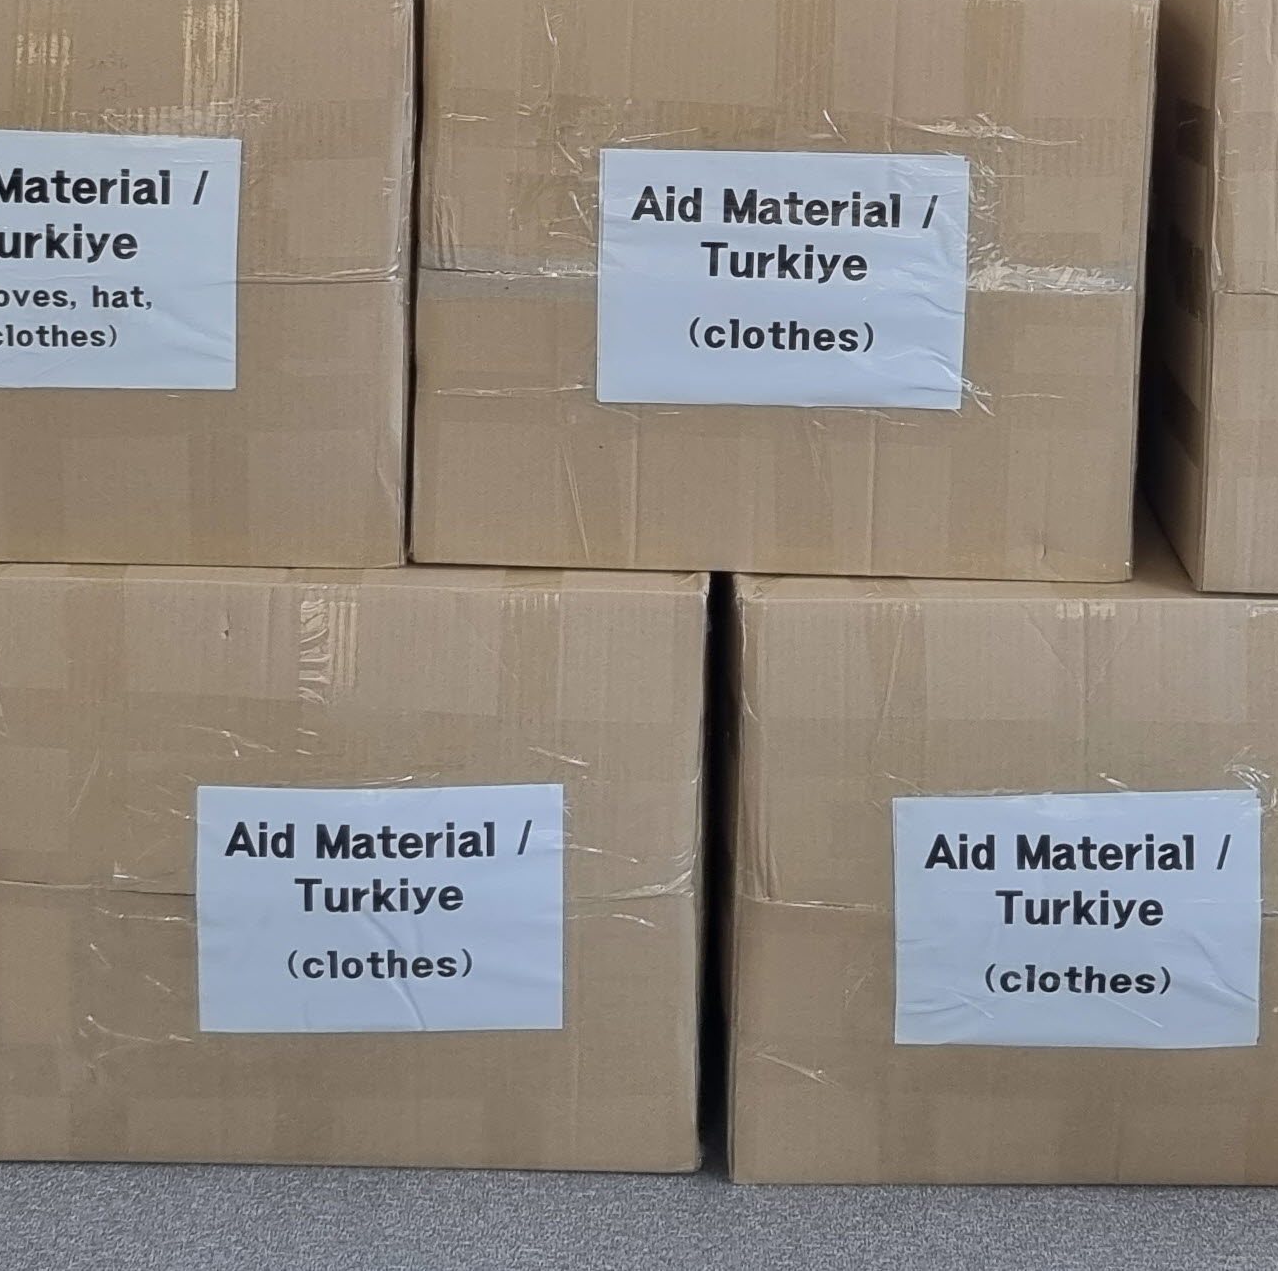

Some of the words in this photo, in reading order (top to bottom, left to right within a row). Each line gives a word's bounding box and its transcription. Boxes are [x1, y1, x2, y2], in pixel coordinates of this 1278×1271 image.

[192, 170, 209, 206] /
[630, 185, 703, 223] Aid
[722, 188, 901, 229] Material
[921, 194, 939, 229] /
[700, 241, 868, 285] Turkiye
[92, 284, 152, 311] hat,
[689, 316, 874, 353] (clothes)
[224, 821, 295, 859] Aid
[315, 821, 496, 860] Material
[516, 819, 533, 856] /
[924, 833, 996, 871] Aid
[1016, 833, 1195, 871] Material
[1216, 834, 1232, 871] /
[293, 877, 464, 916] Turkiye
[995, 889, 1164, 930] Turkiye
[287, 948, 473, 980] (clothes)
[984, 963, 1171, 995] (clothes)
